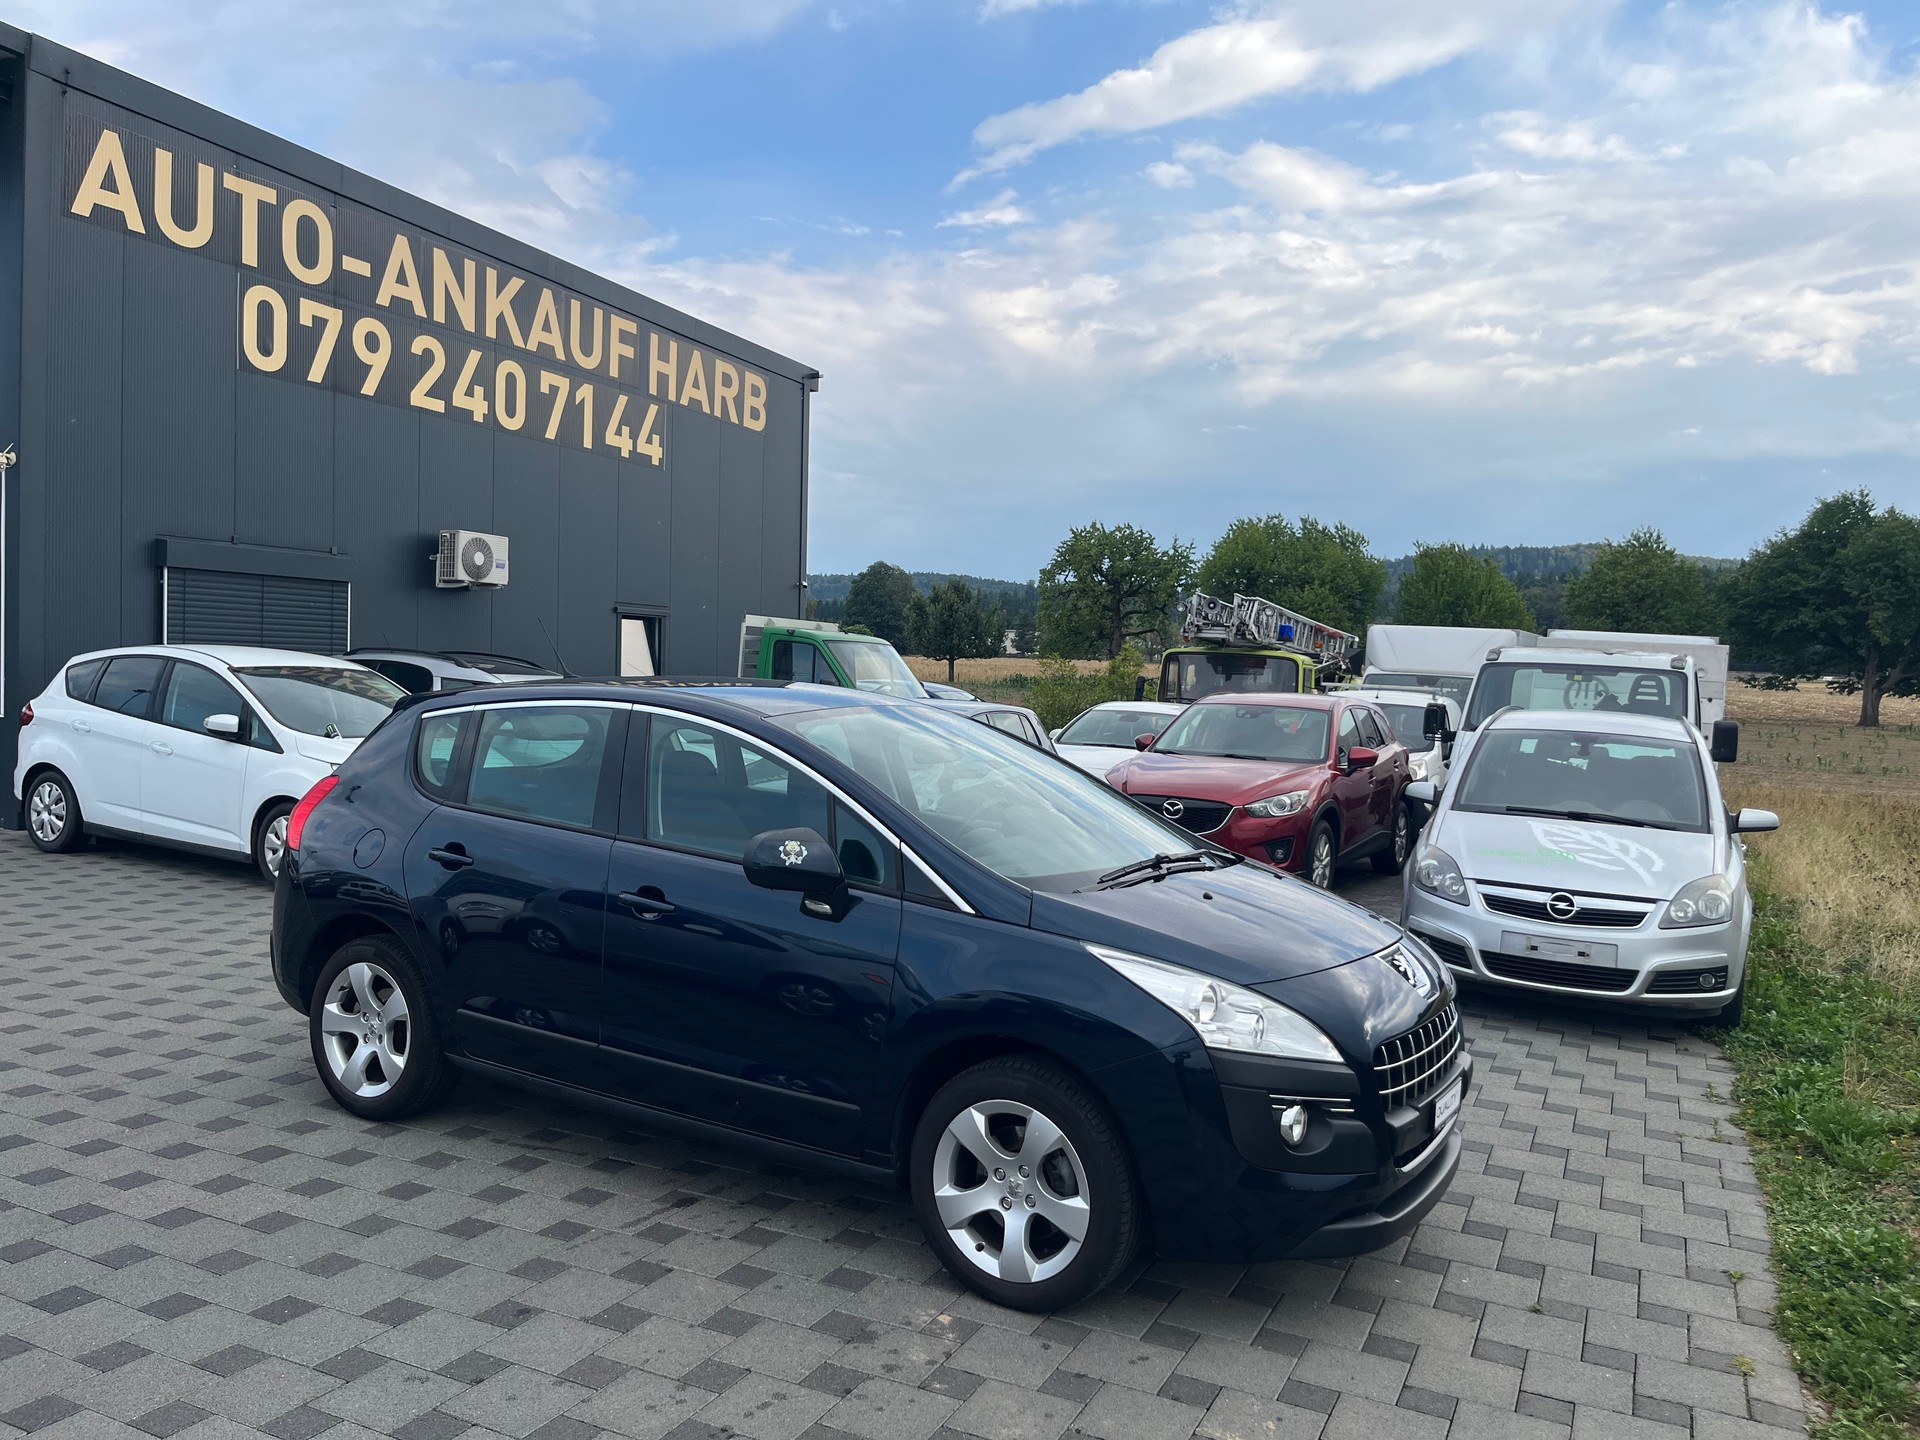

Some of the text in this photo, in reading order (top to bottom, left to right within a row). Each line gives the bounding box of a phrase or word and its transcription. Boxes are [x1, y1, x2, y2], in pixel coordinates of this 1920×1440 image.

[70, 129, 768, 432] AUTO-ANKAUF HARB
[242, 284, 393, 396] 079
[410, 335, 528, 431] 240
